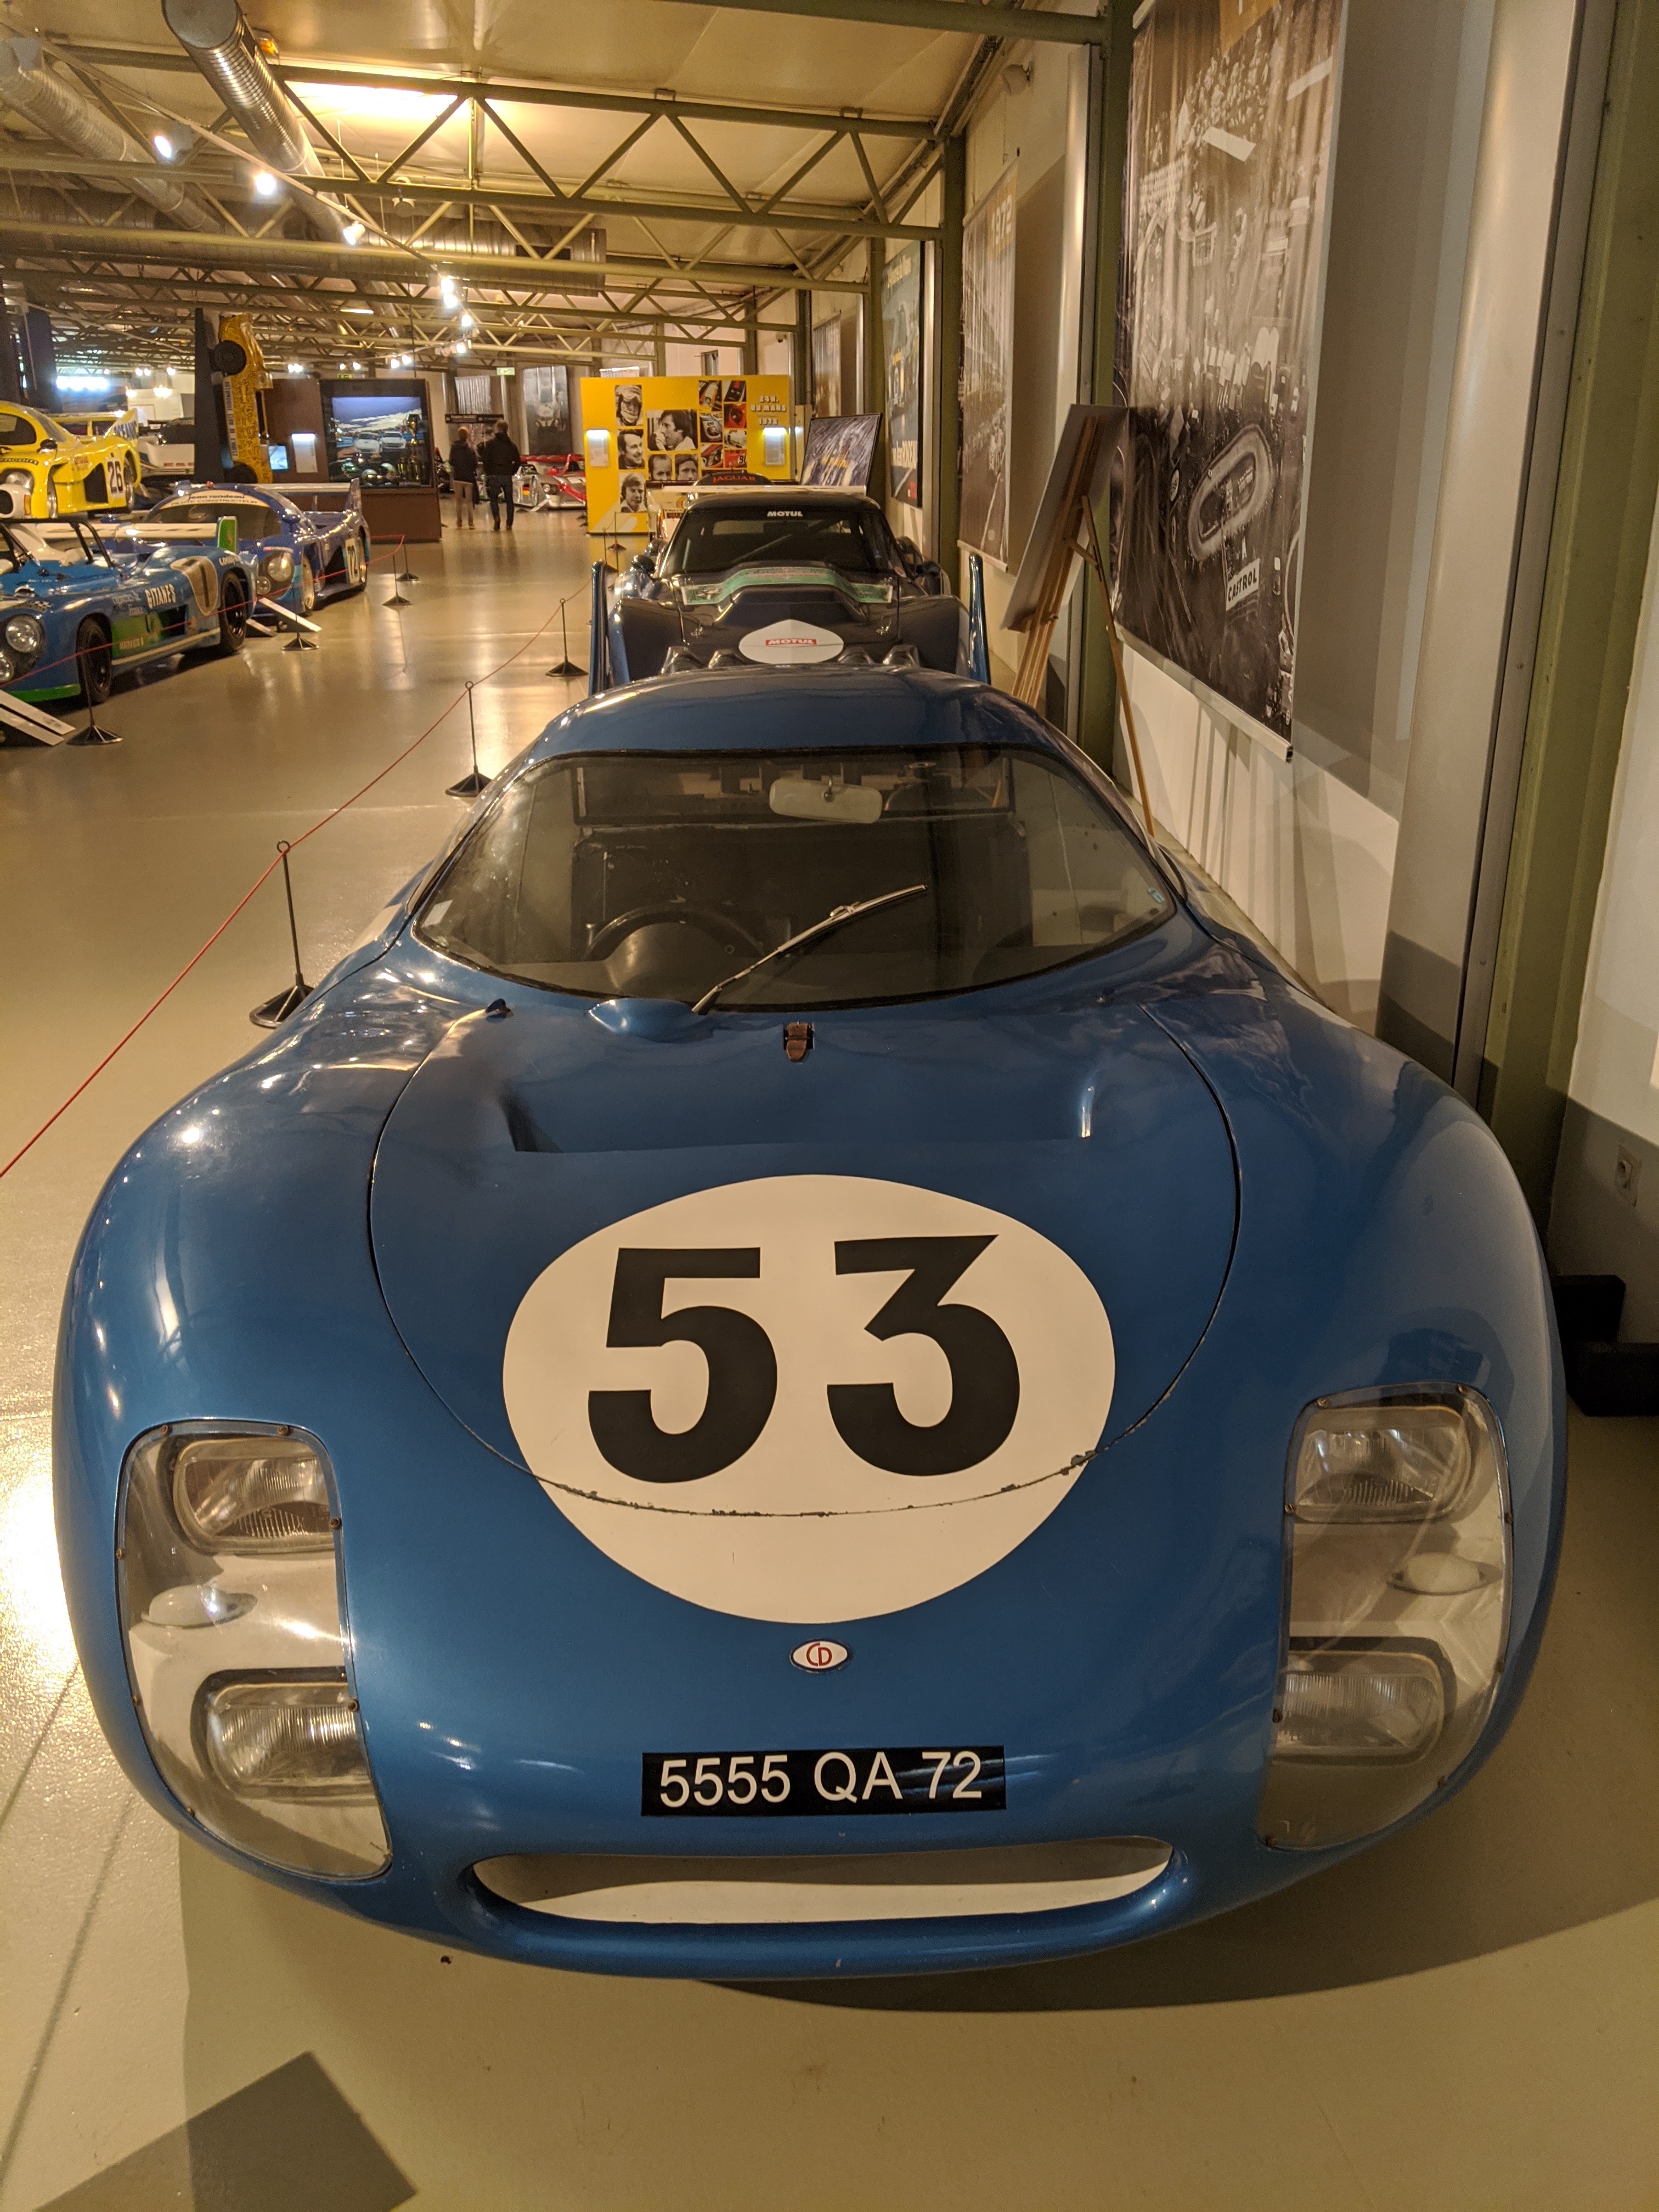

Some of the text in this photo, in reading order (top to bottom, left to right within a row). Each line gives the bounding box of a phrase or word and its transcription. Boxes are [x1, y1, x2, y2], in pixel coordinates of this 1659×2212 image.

[107, 460, 123, 494] 26
[713, 475, 757, 483] JAGUAR
[347, 545, 358, 578] 72
[145, 583, 176, 610] GITANES
[1228, 567, 1257, 602] CASTROL
[588, 1234, 1020, 1483] 53
[660, 1751, 983, 1808] 5555 QA 72
